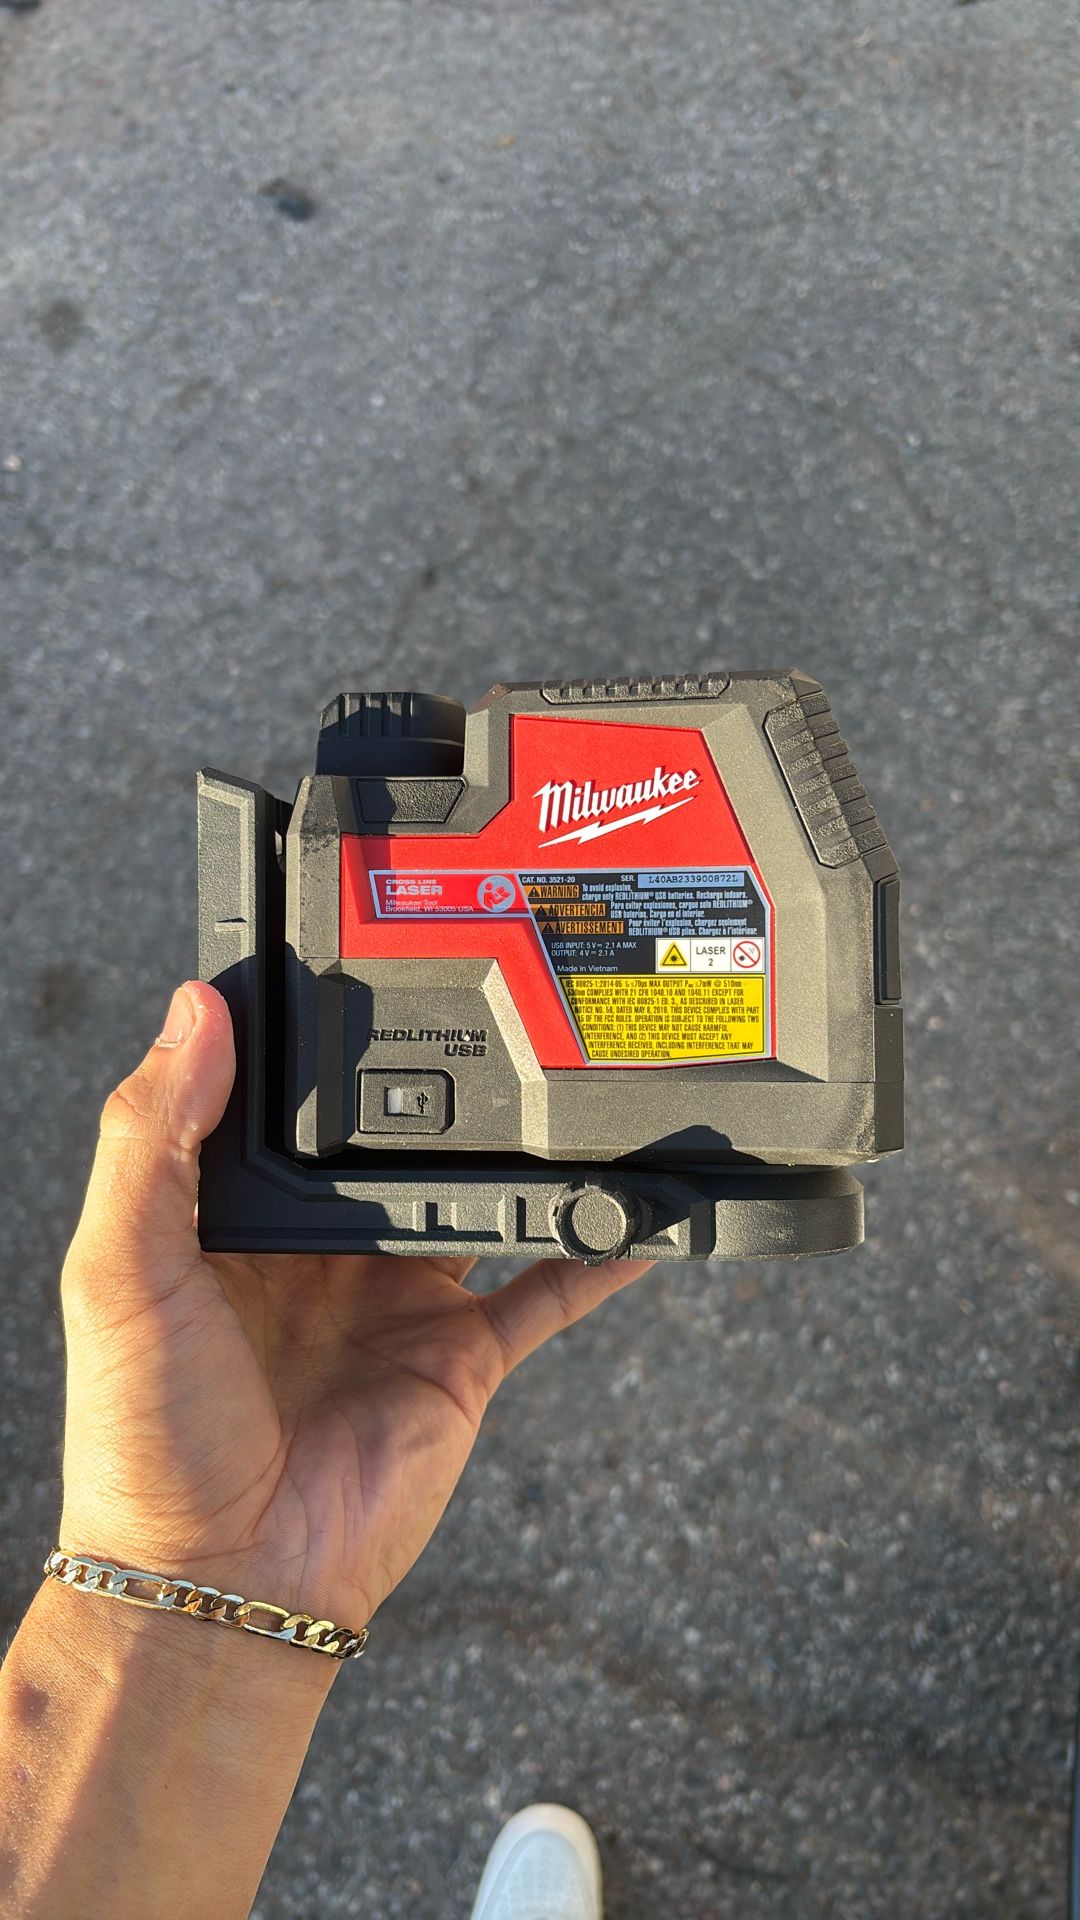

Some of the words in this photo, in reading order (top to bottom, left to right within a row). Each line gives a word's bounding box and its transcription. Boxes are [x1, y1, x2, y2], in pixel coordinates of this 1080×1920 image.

[532, 765, 703, 834] Milwaukee
[648, 875, 738, 883] L40AB233900872L
[385, 885, 443, 895] LASER
[541, 885, 578, 898] WARNING
[582, 892, 601, 900] charge
[602, 892, 614, 901] only
[655, 892, 666, 900] USB
[668, 892, 695, 900] batteries.
[696, 891, 723, 900] Recharge
[549, 904, 604, 916] ADVERTENCIA
[556, 922, 622, 933] AVERTISSEMENT
[696, 946, 726, 955] LASER
[366, 1028, 488, 1042] REDLITHIUM
[444, 1043, 487, 1056] USB
